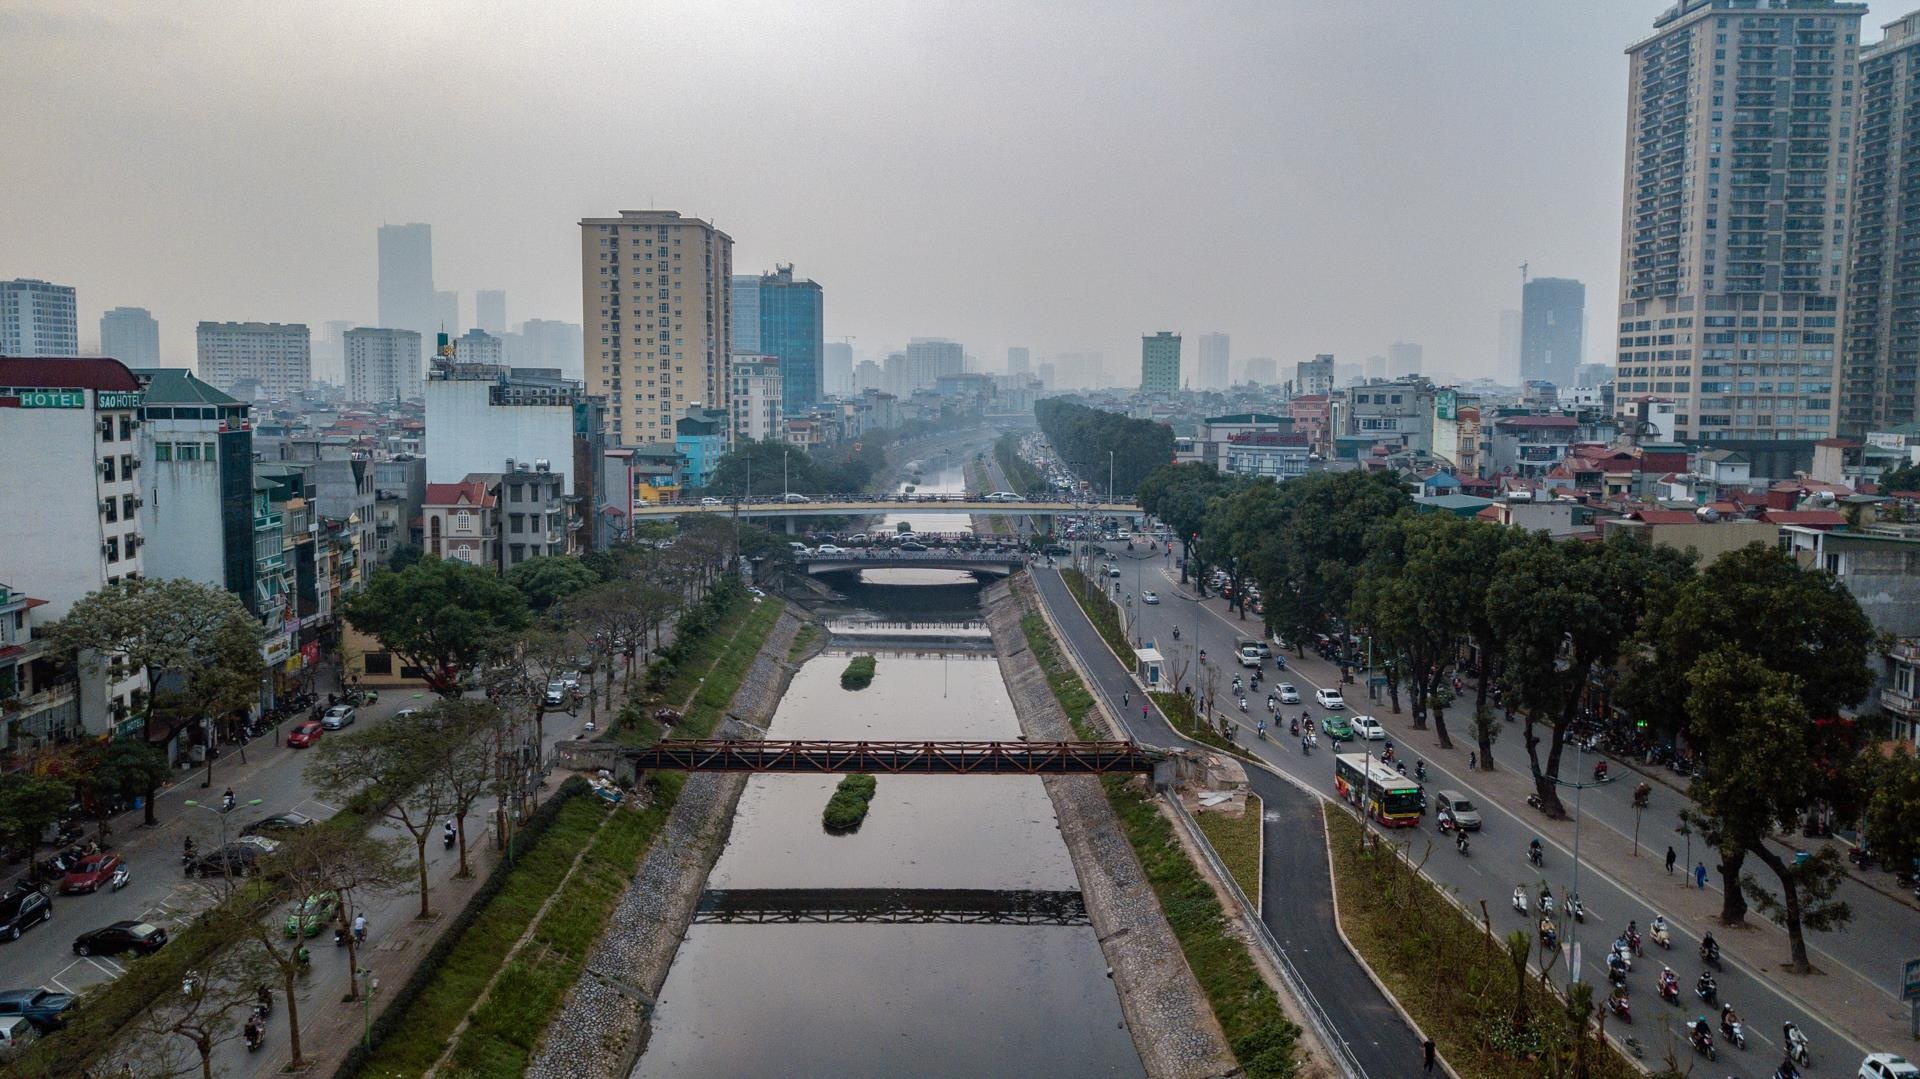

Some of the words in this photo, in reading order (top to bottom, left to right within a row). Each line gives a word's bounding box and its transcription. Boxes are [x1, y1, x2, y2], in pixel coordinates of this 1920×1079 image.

[22, 394, 81, 406] HOTEL
[99, 395, 116, 408] SAO
[116, 395, 142, 407] HOTEL
